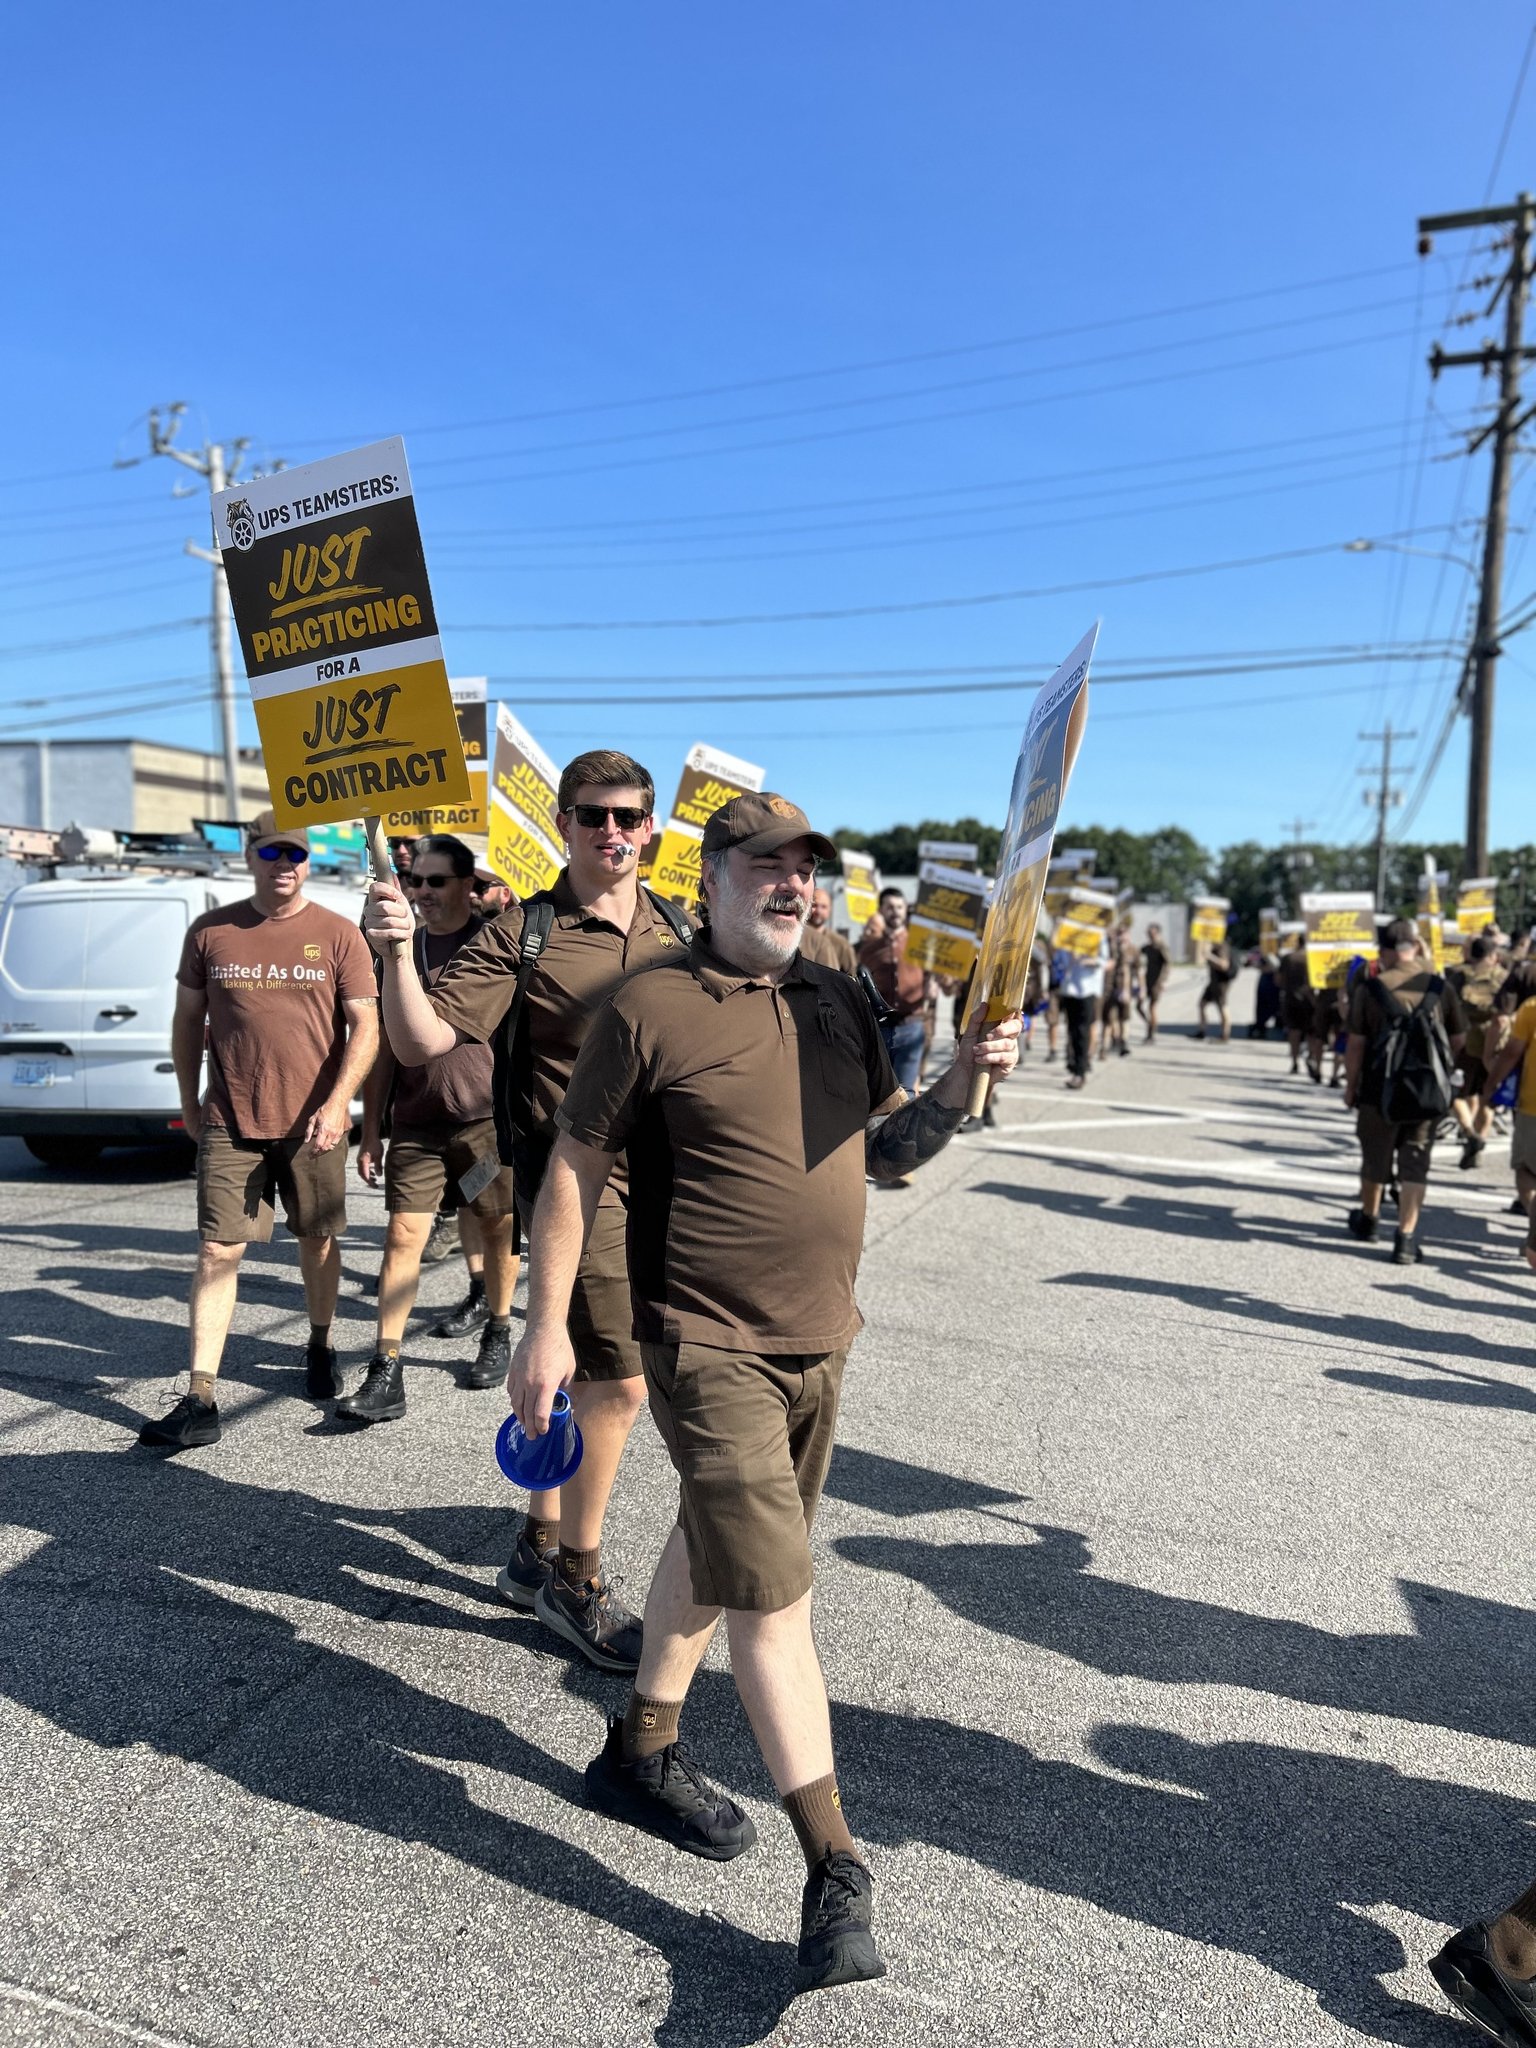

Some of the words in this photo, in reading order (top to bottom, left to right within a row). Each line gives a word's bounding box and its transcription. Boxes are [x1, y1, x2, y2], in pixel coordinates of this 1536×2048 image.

[258, 505, 291, 530] UPS
[292, 474, 400, 520] TEAMSTERS:
[268, 526, 372, 601] JUST
[251, 594, 422, 663] PRACTICING
[316, 660, 345, 681] FOR
[348, 657, 361, 674] A
[302, 683, 401, 749] JUST
[284, 748, 448, 808] CONTRACT
[512, 762, 557, 809] JUST
[387, 808, 481, 827] CONTRACT
[495, 852, 541, 894] CONTR
[507, 832, 554, 876] JUST
[256, 981, 263, 989] A
[266, 980, 313, 991] Difference
[267, 964, 288, 980] As
[293, 964, 326, 982] One
